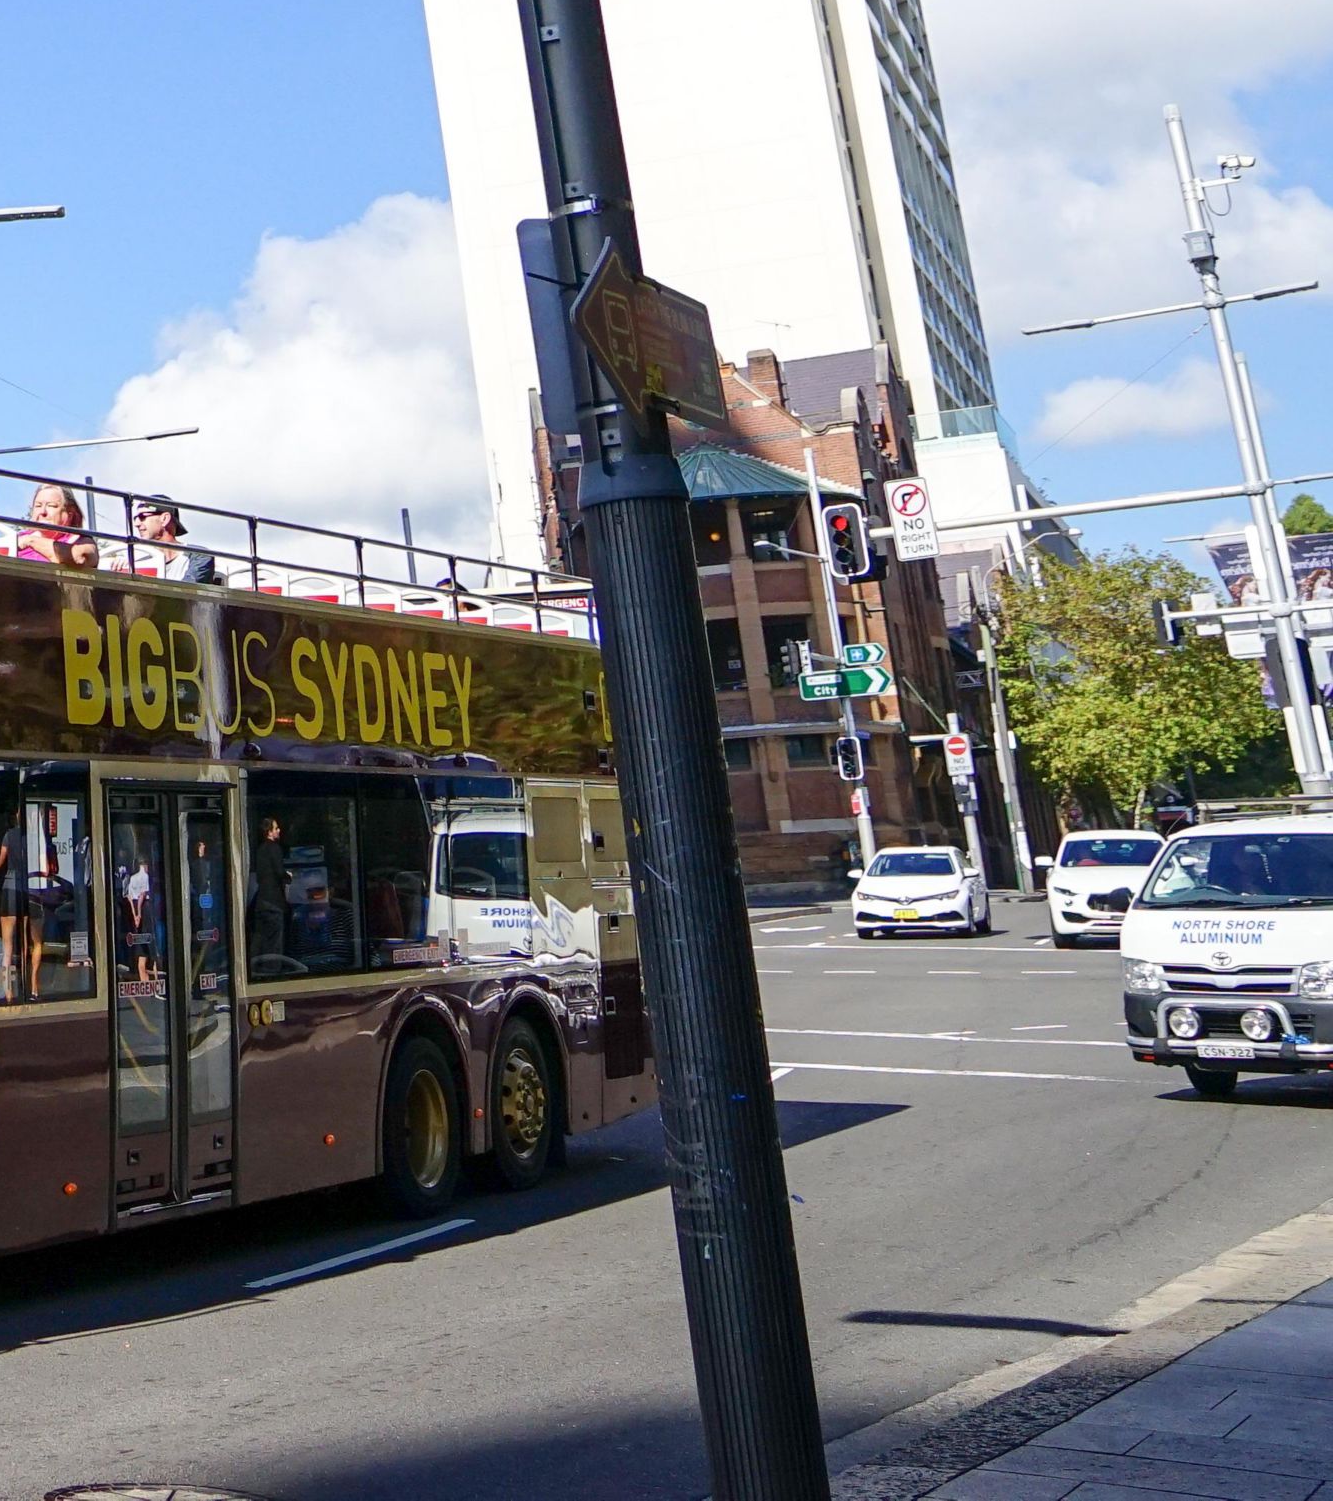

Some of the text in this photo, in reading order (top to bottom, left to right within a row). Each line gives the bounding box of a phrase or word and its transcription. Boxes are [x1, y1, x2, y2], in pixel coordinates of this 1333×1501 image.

[903, 518, 925, 531] NO
[901, 532, 931, 543] RIGHT
[904, 544, 933, 553] TURN
[290, 637, 472, 747] SYDNEY
[813, 685, 838, 696] City
[1172, 920, 1276, 931] NORTH SHORE
[1180, 932, 1263, 944] ALUMINIUM
[119, 980, 165, 997] EMERGENCY
[201, 975, 216, 990] EXIT
